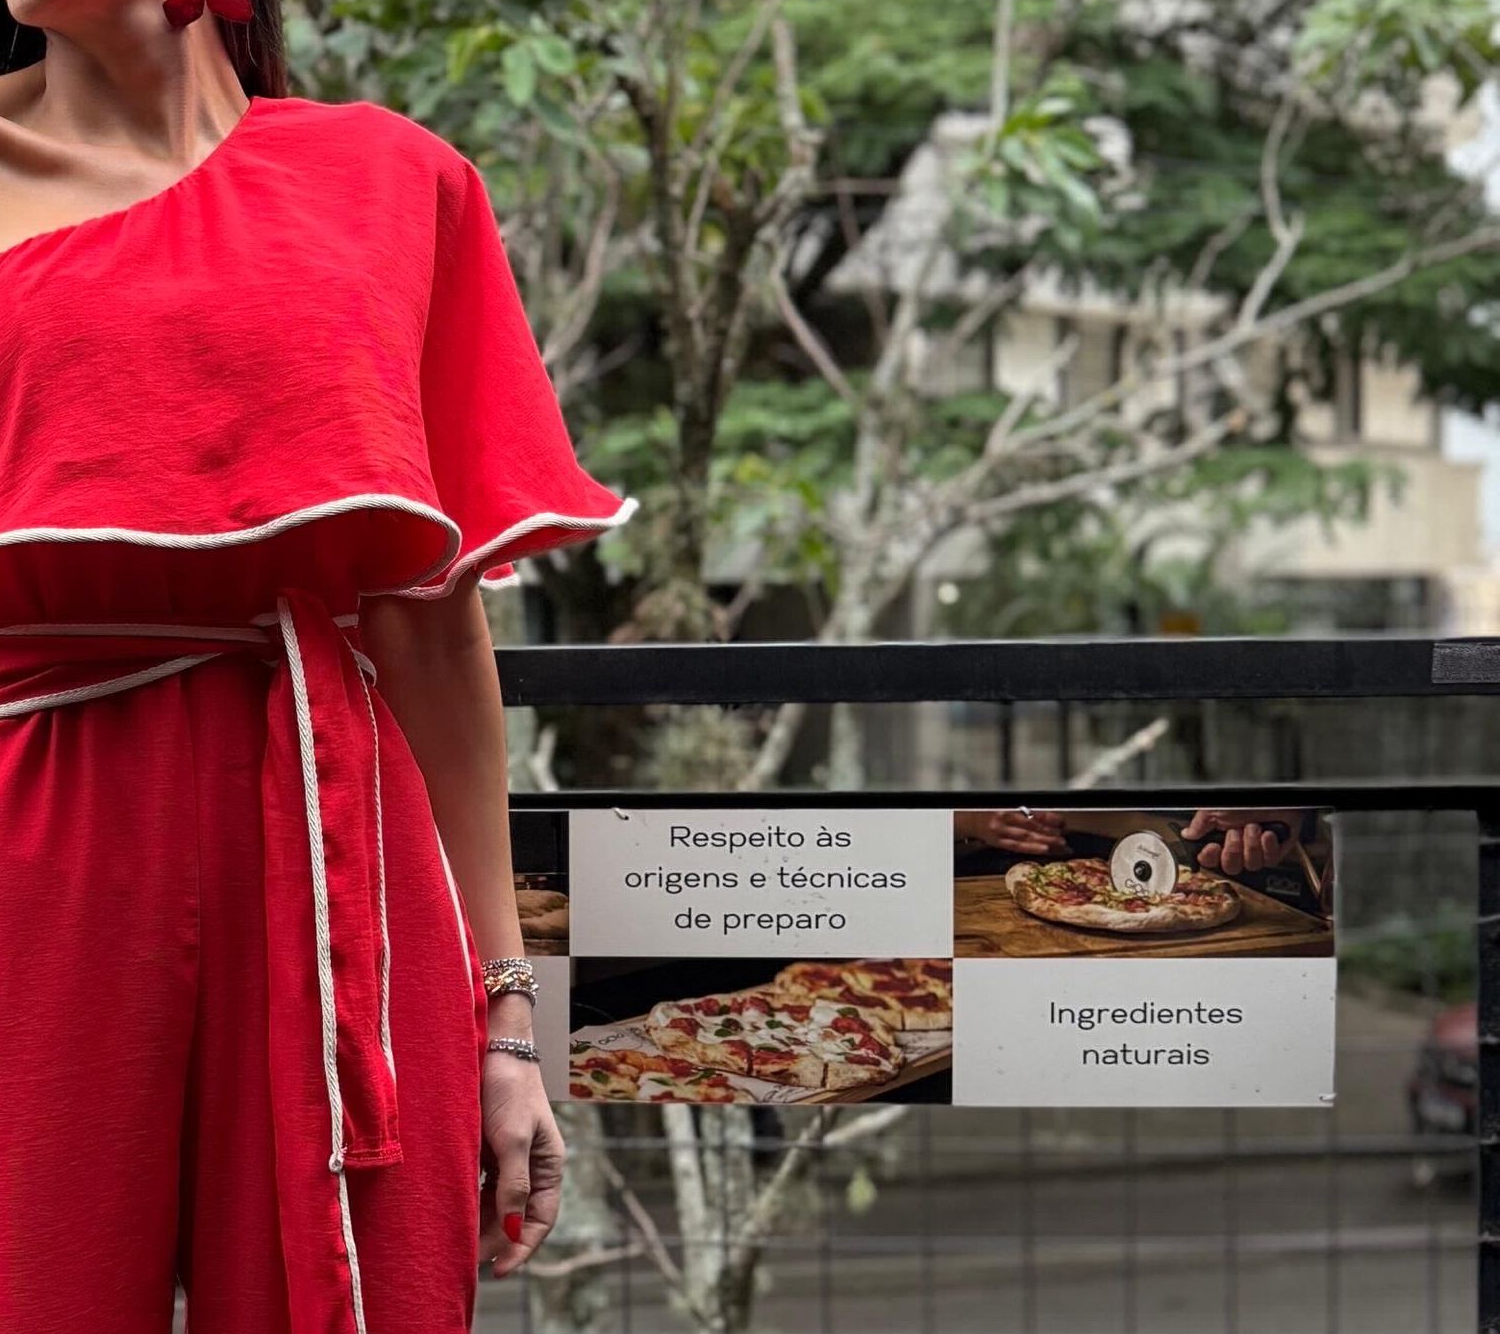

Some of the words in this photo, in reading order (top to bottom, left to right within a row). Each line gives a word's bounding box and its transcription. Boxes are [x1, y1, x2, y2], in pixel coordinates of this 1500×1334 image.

[670, 825, 805, 854] Respeito
[817, 825, 852, 848] às
[624, 867, 739, 894] origens
[749, 873, 766, 889] e
[776, 866, 907, 889] técnicas
[674, 907, 711, 930] de
[722, 912, 846, 936] preparo
[1049, 1001, 1243, 1031] Ingredientes
[1082, 1042, 1210, 1065] naturais
